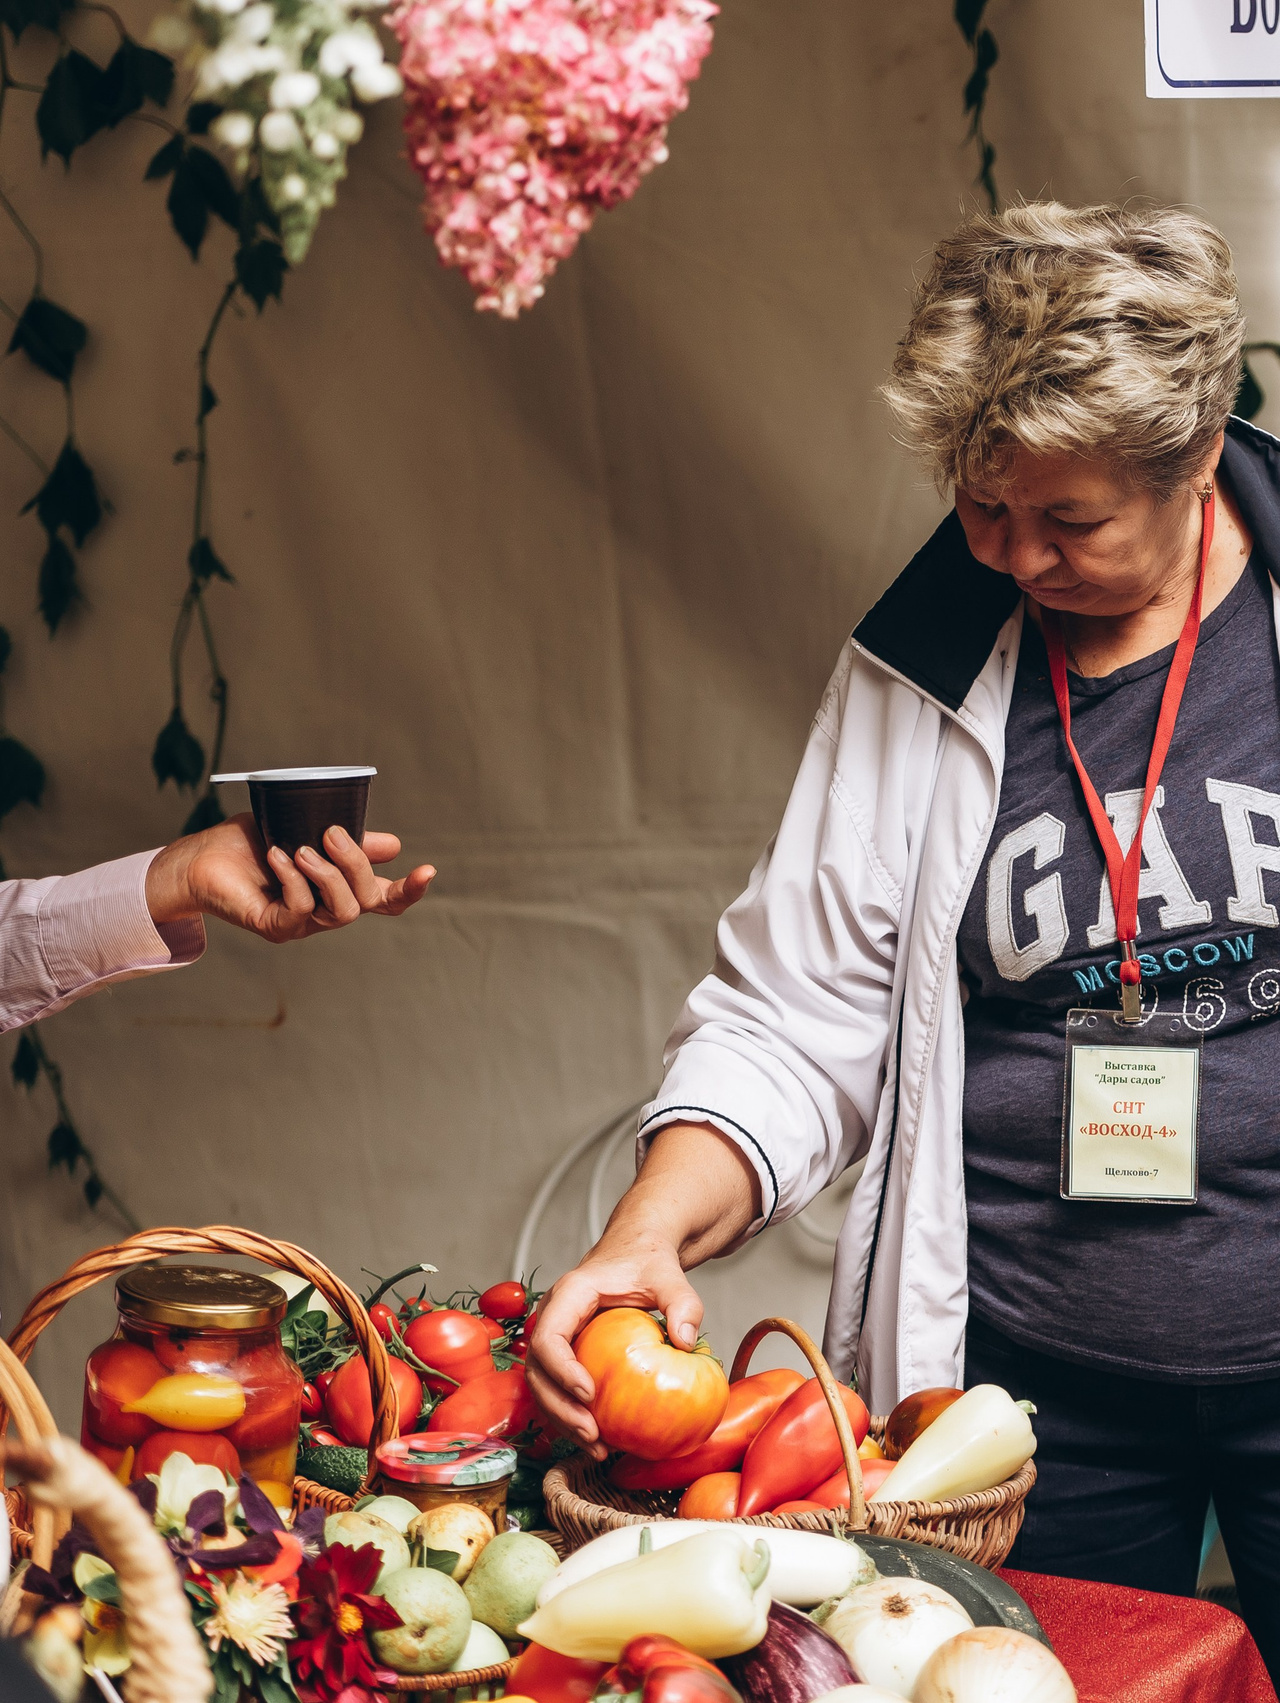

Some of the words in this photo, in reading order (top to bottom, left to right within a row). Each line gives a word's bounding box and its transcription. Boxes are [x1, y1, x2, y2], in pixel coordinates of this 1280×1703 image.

[1072, 933, 1256, 994] MOSCOW
[1104, 1061, 1156, 1071] Выставка
[1112, 1101, 1145, 1114] СНТ
[1079, 1123, 1177, 1140] «ВОСХОД-4»
[1104, 1167, 1158, 1178] Щелково-7
